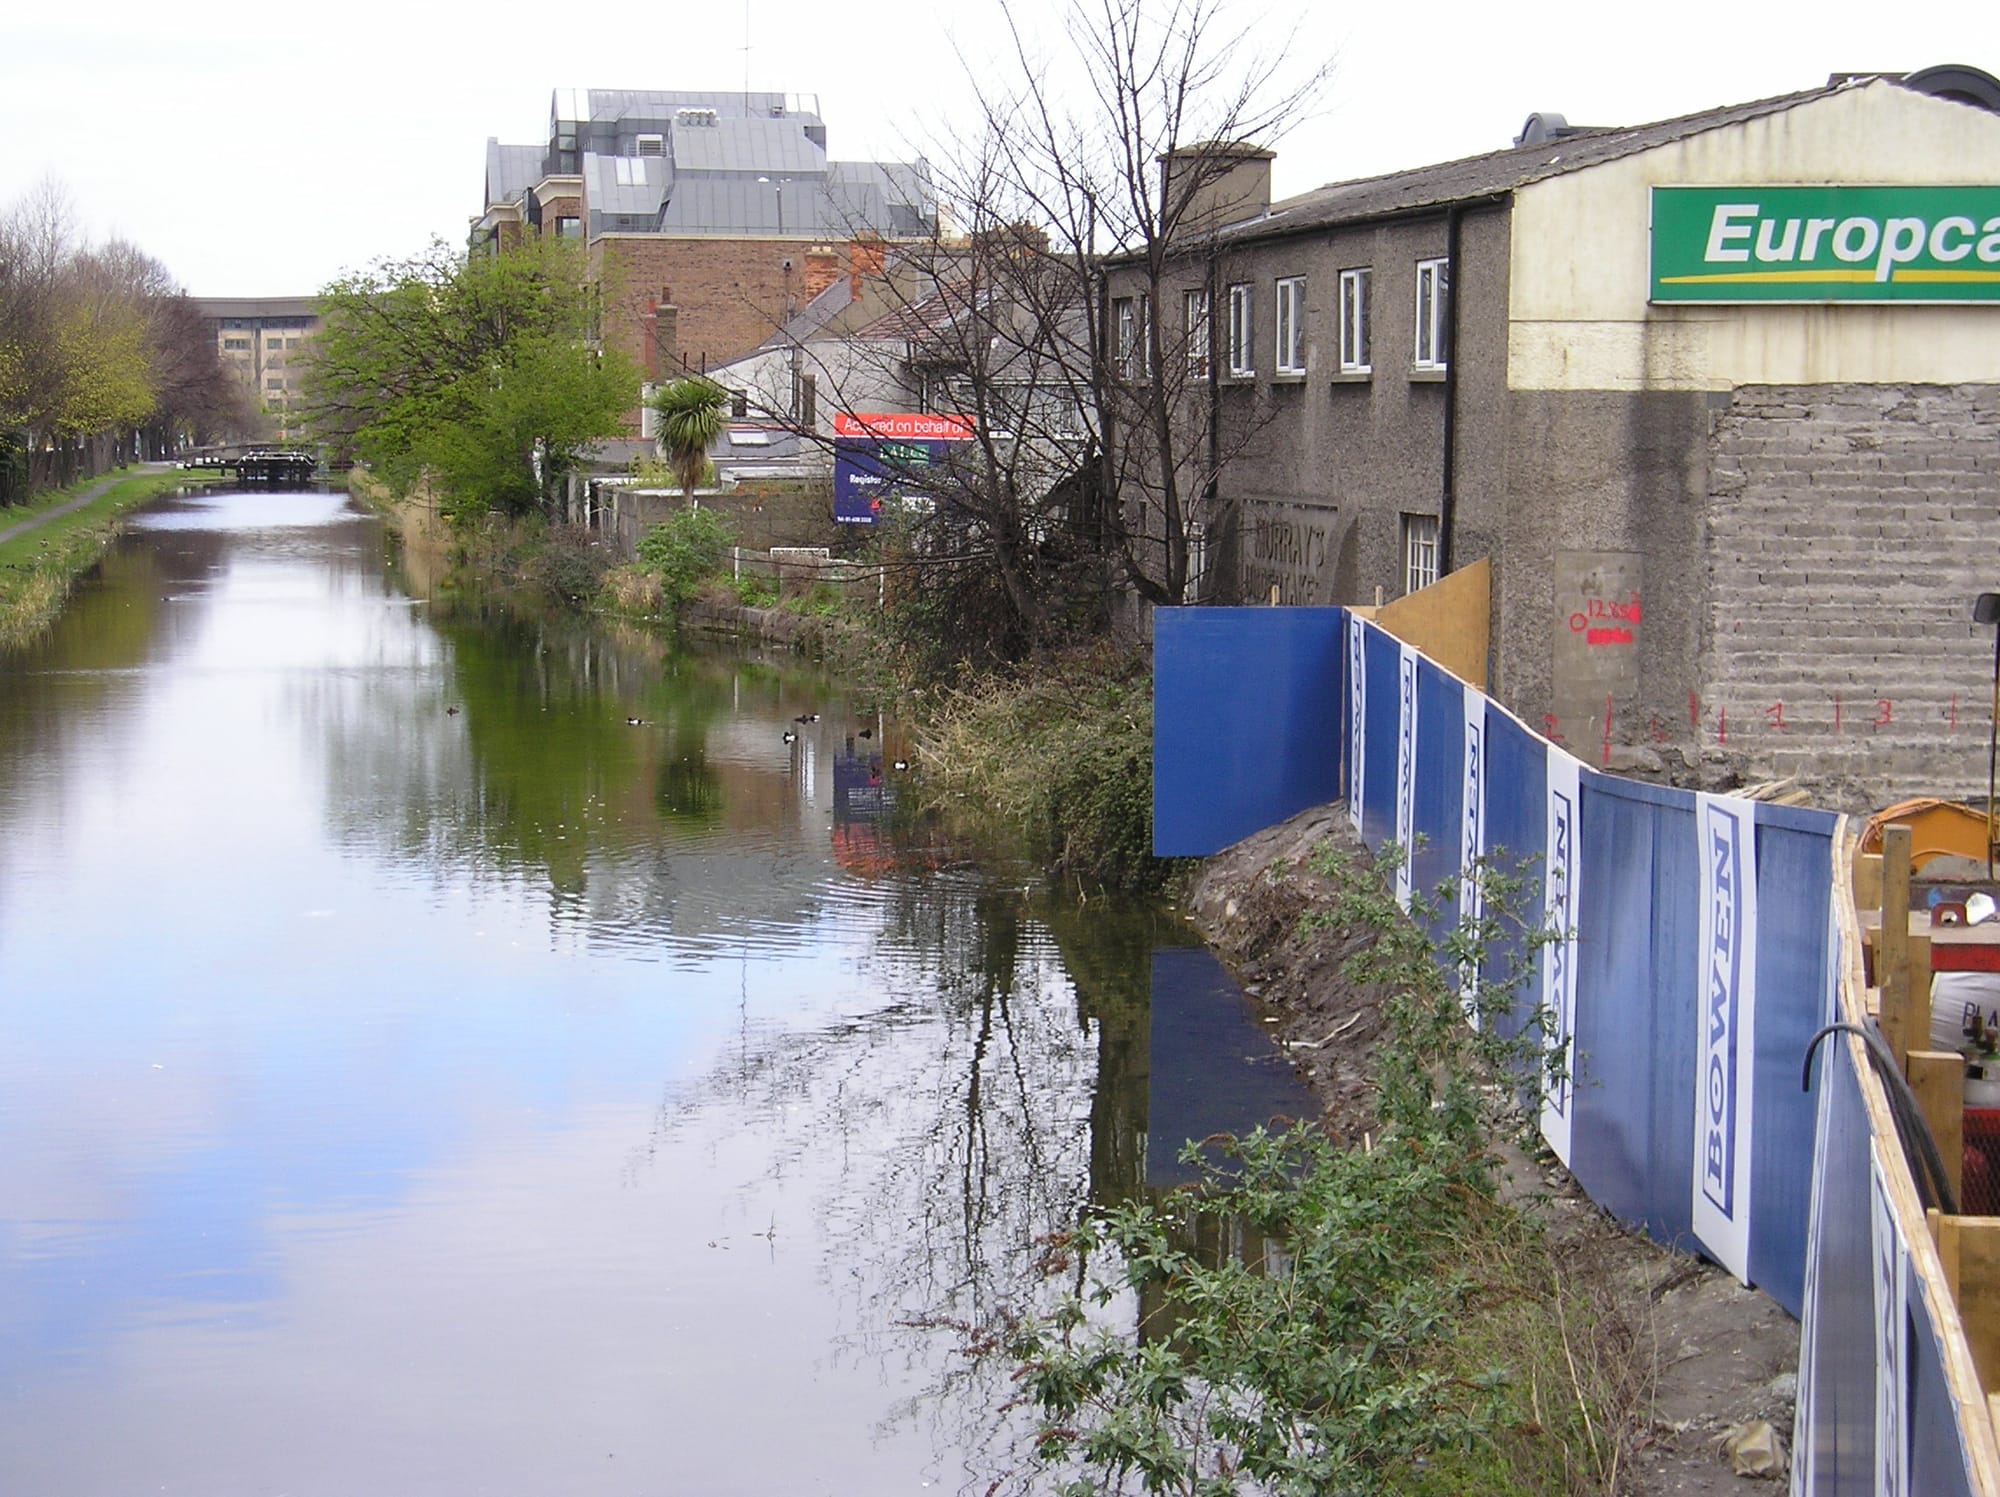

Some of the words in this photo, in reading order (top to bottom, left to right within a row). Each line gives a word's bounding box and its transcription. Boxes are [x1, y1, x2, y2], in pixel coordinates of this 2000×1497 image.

[896, 420, 911, 433] on
[914, 419, 949, 434] behalf
[1873, 700, 1892, 726] 3
[1705, 828, 1733, 1191] BOWEN
